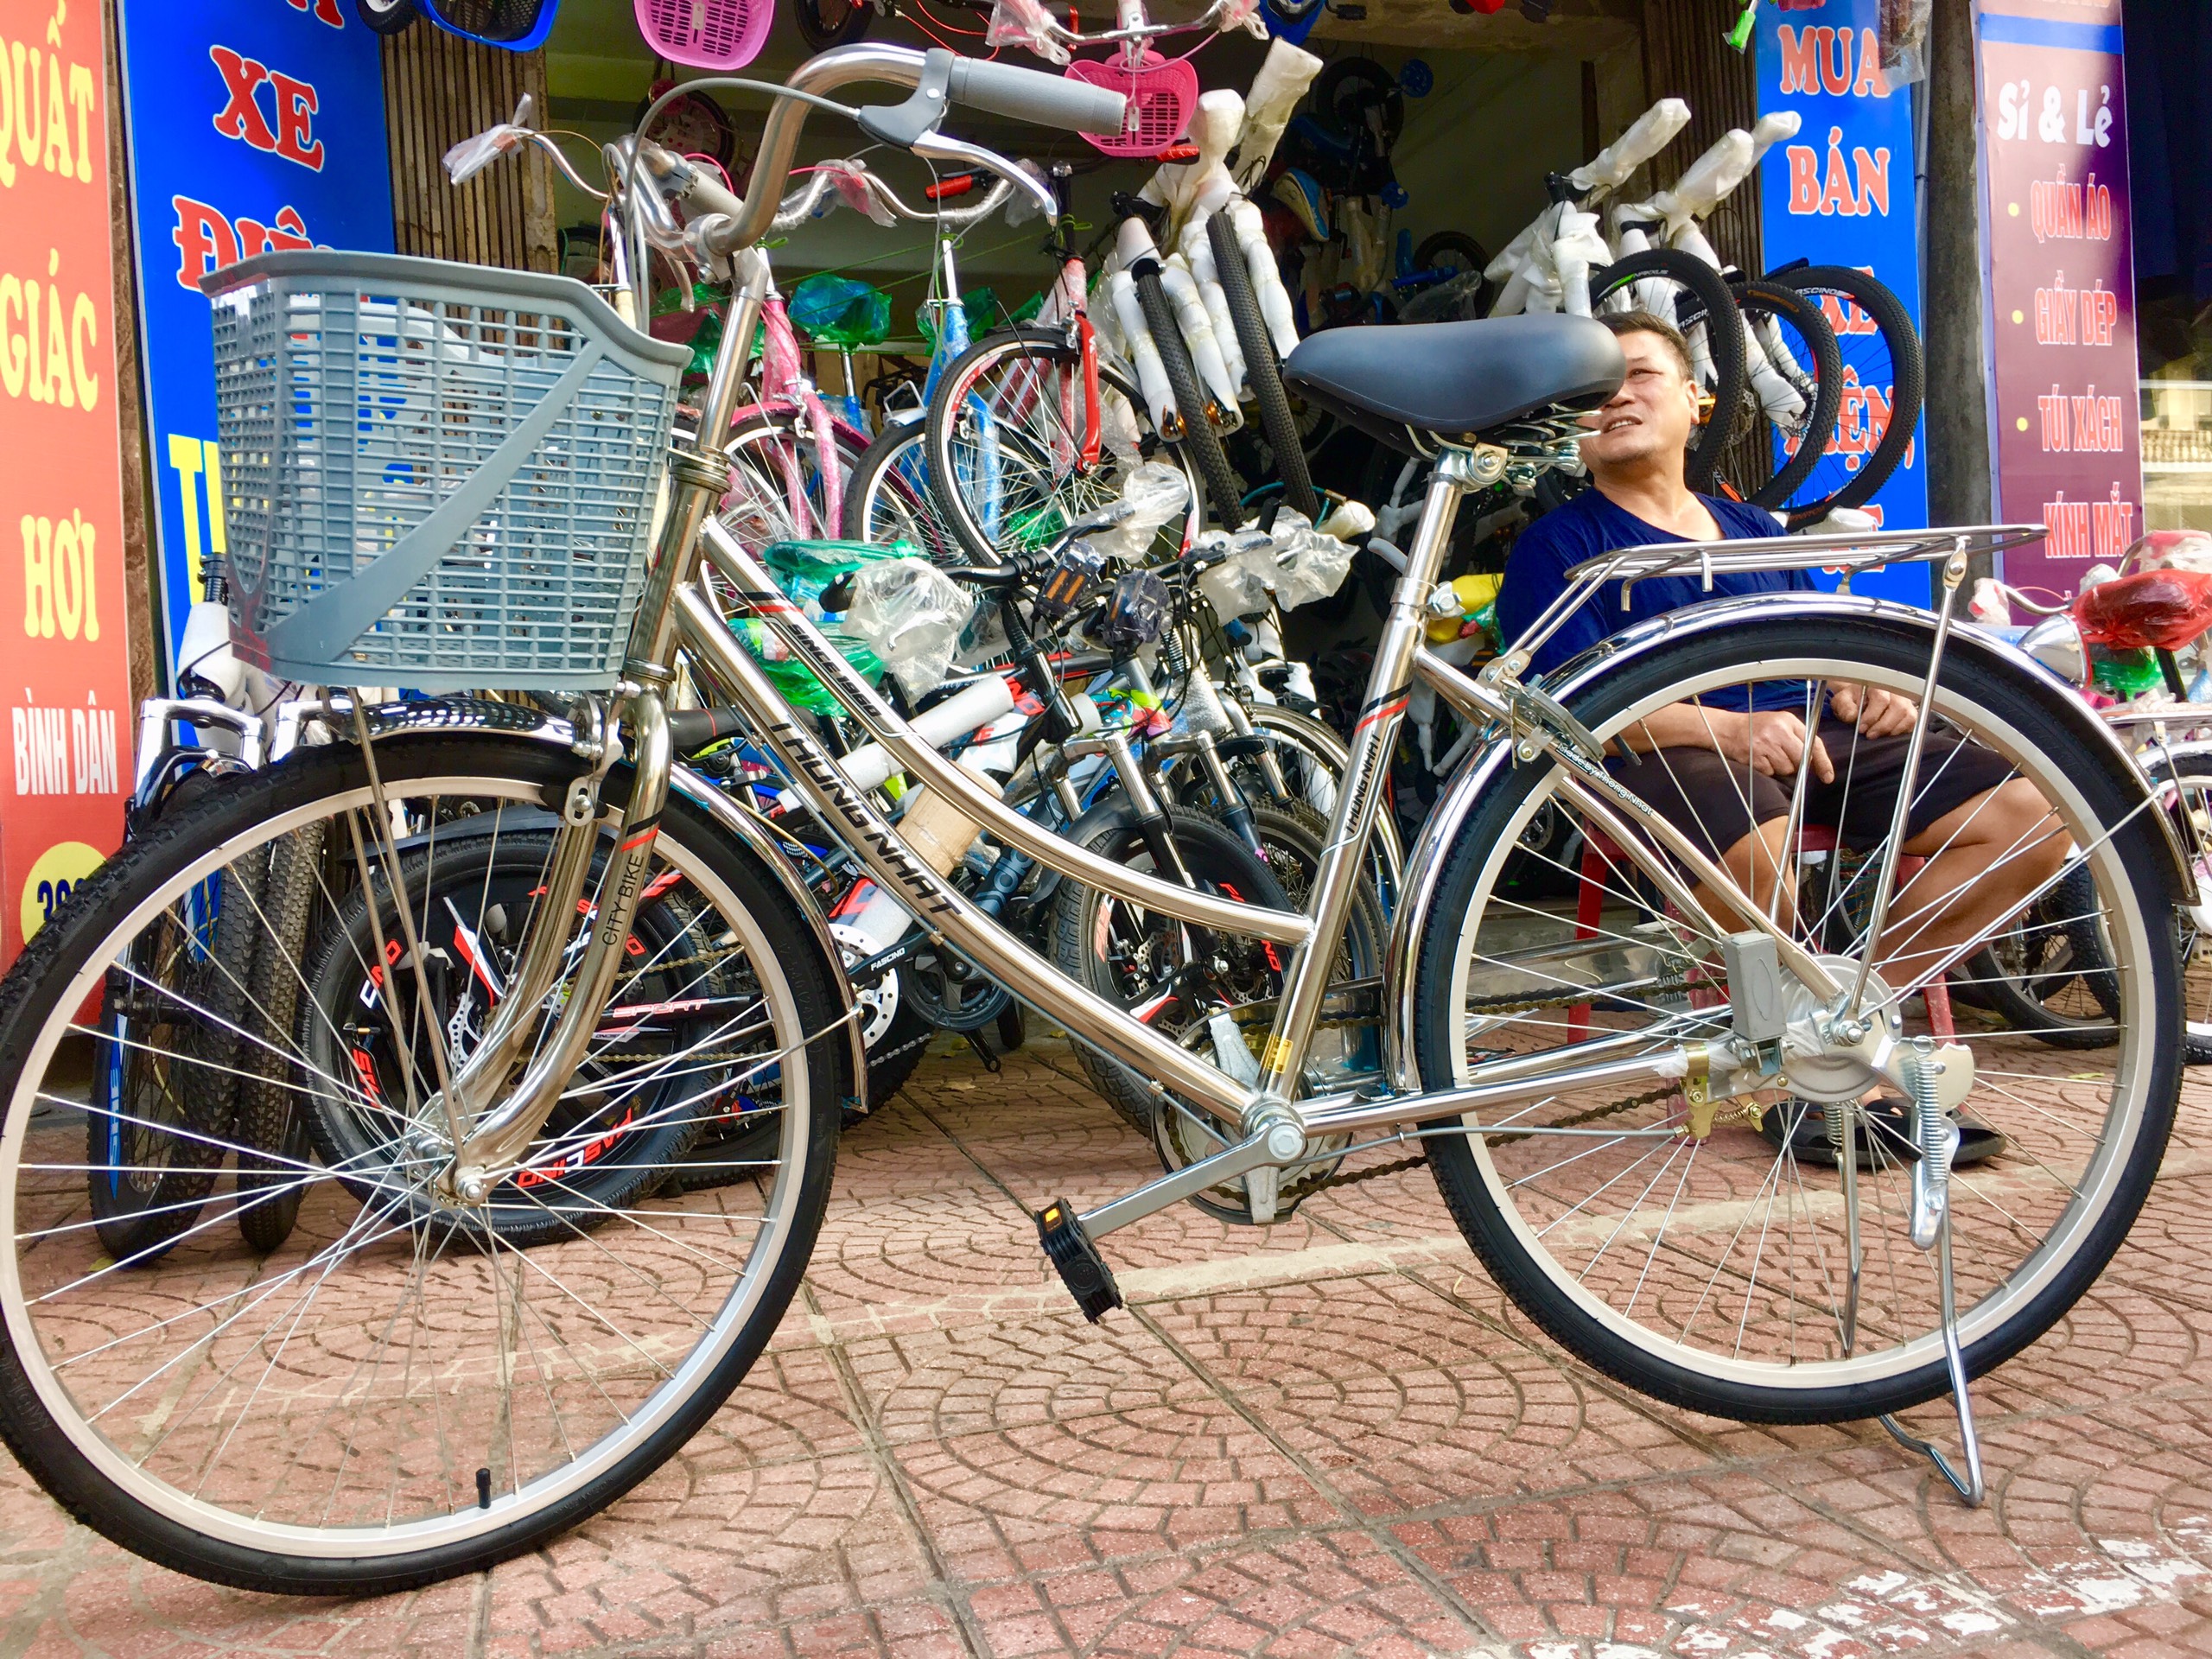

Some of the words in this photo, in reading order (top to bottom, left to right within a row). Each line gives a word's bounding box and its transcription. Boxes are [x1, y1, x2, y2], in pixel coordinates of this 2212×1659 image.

[1777, 24, 1891, 99] MUA
[209, 45, 325, 173] XE
[1997, 79, 2030, 141] Sỉ
[2038, 86, 2067, 143] &
[2076, 85, 2113, 148] Lẻ
[1786, 125, 1891, 217] BÁN
[2031, 162, 2083, 244] QUẦN
[2086, 173, 2111, 241] ÁO
[0, 247, 99, 412] GIÁC
[2081, 279, 2117, 346] DÉP
[2037, 384, 2070, 452] TÚI
[2071, 385, 2123, 452] XÁCH
[2043, 490, 2091, 559] KÍNH
[21, 507, 99, 642] HƠI
[787, 623, 836, 673] SINCE
[837, 673, 883, 718] 1960
[12, 687, 69, 796] BÌNH
[72, 690, 118, 795] DÂN
[1557, 742, 1585, 767] Made
[602, 900, 626, 946] CITY
[619, 854, 645, 899] BIKE
[864, 830, 963, 916] NHAT
[870, 947, 906, 971] FASCINO
[613, 998, 709, 1018] SPORT
[518, 1106, 634, 1188] FASCINO
